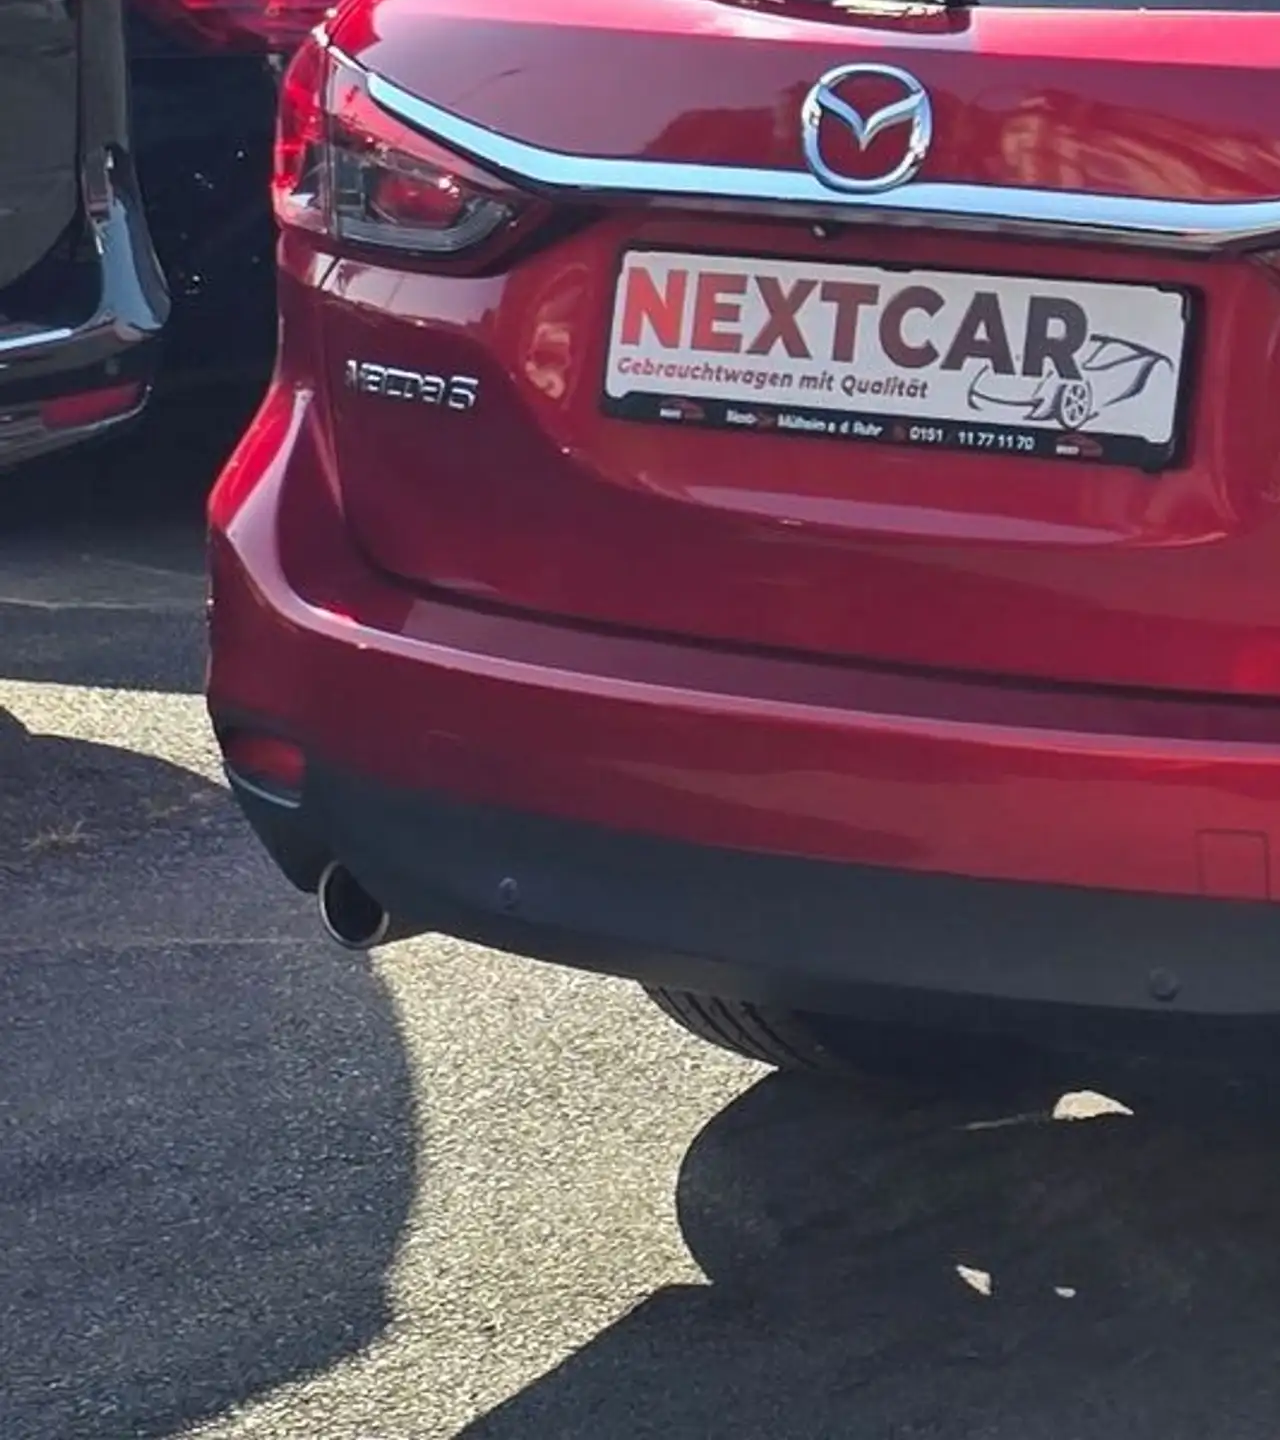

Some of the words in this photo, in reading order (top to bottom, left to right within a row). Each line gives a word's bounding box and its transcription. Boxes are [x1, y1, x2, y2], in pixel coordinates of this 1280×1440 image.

[618, 266, 1090, 381] NEXTCAR
[617, 356, 794, 391] Gebrauchtwagen
[799, 368, 834, 392] mit
[840, 373, 929, 400] Qualität
